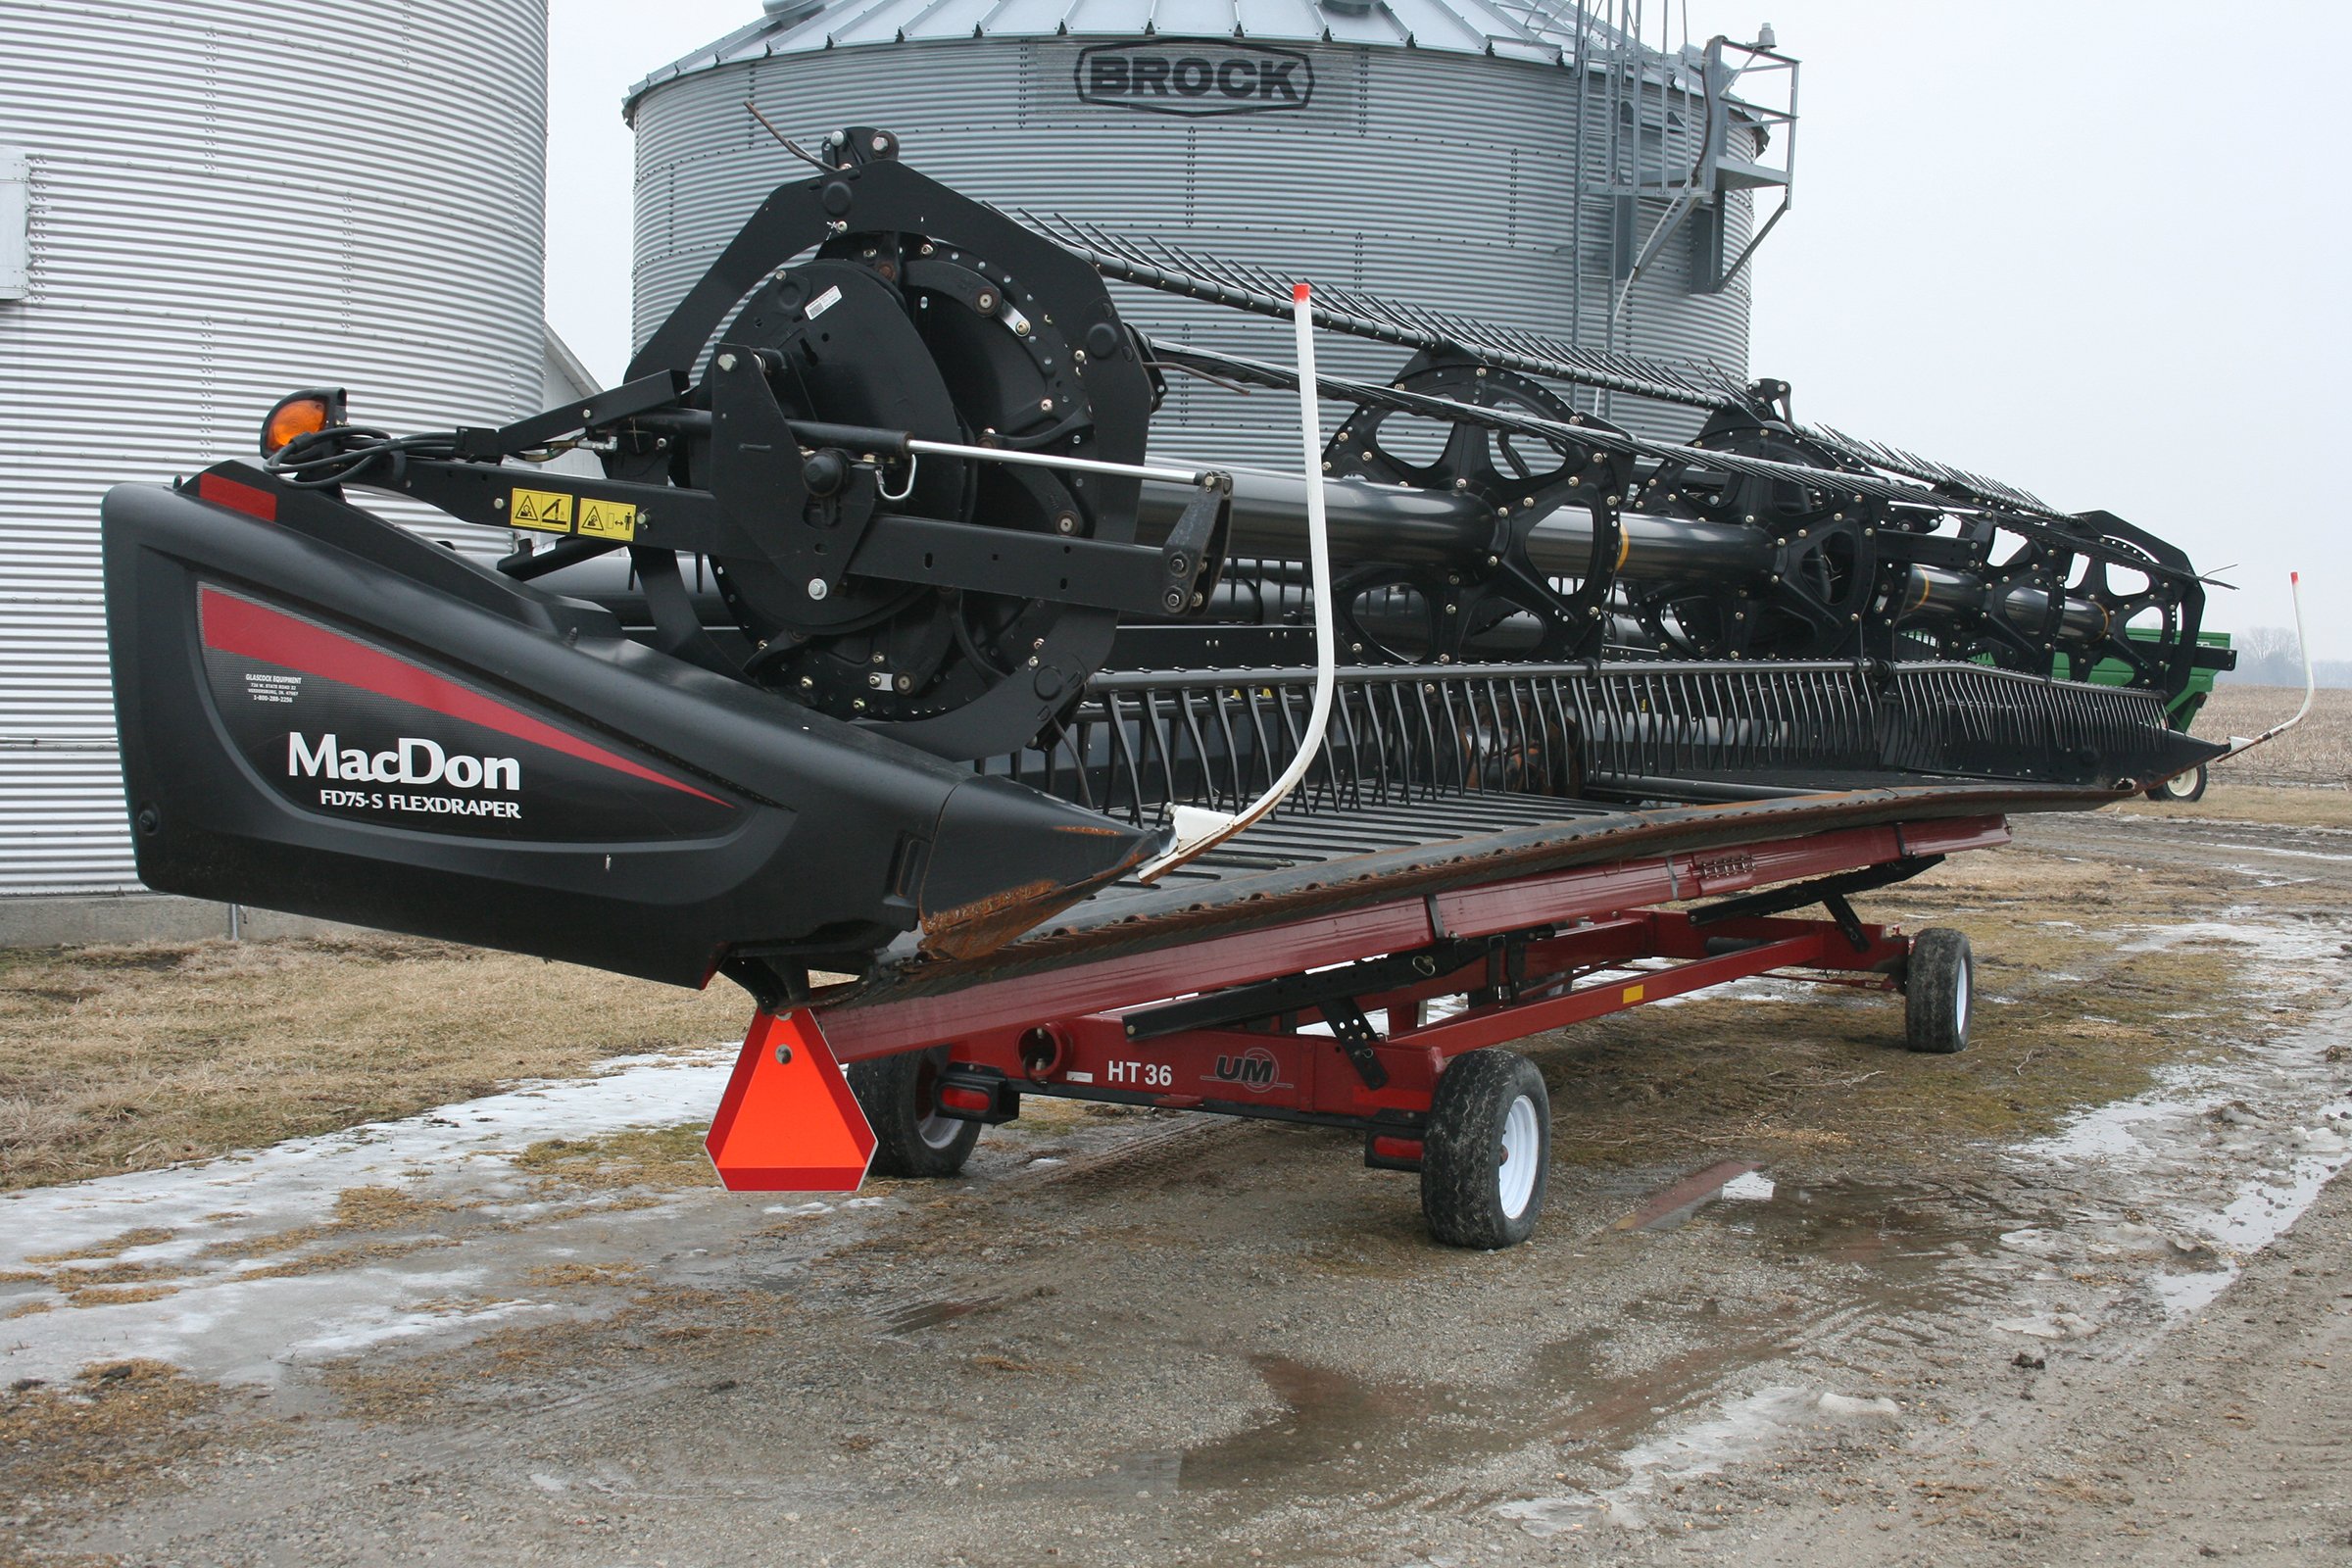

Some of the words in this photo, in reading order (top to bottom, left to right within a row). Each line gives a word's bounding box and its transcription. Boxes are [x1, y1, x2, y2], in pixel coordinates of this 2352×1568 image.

[1090, 56, 1300, 101] BROCK
[272, 675, 302, 684] EQUIPMENT
[288, 731, 520, 791] MacDon
[388, 794, 521, 819] FLEXDRAPER
[1107, 1059, 1142, 1083] HT
[1145, 1063, 1173, 1087] 36
[1214, 1054, 1274, 1083] UM
